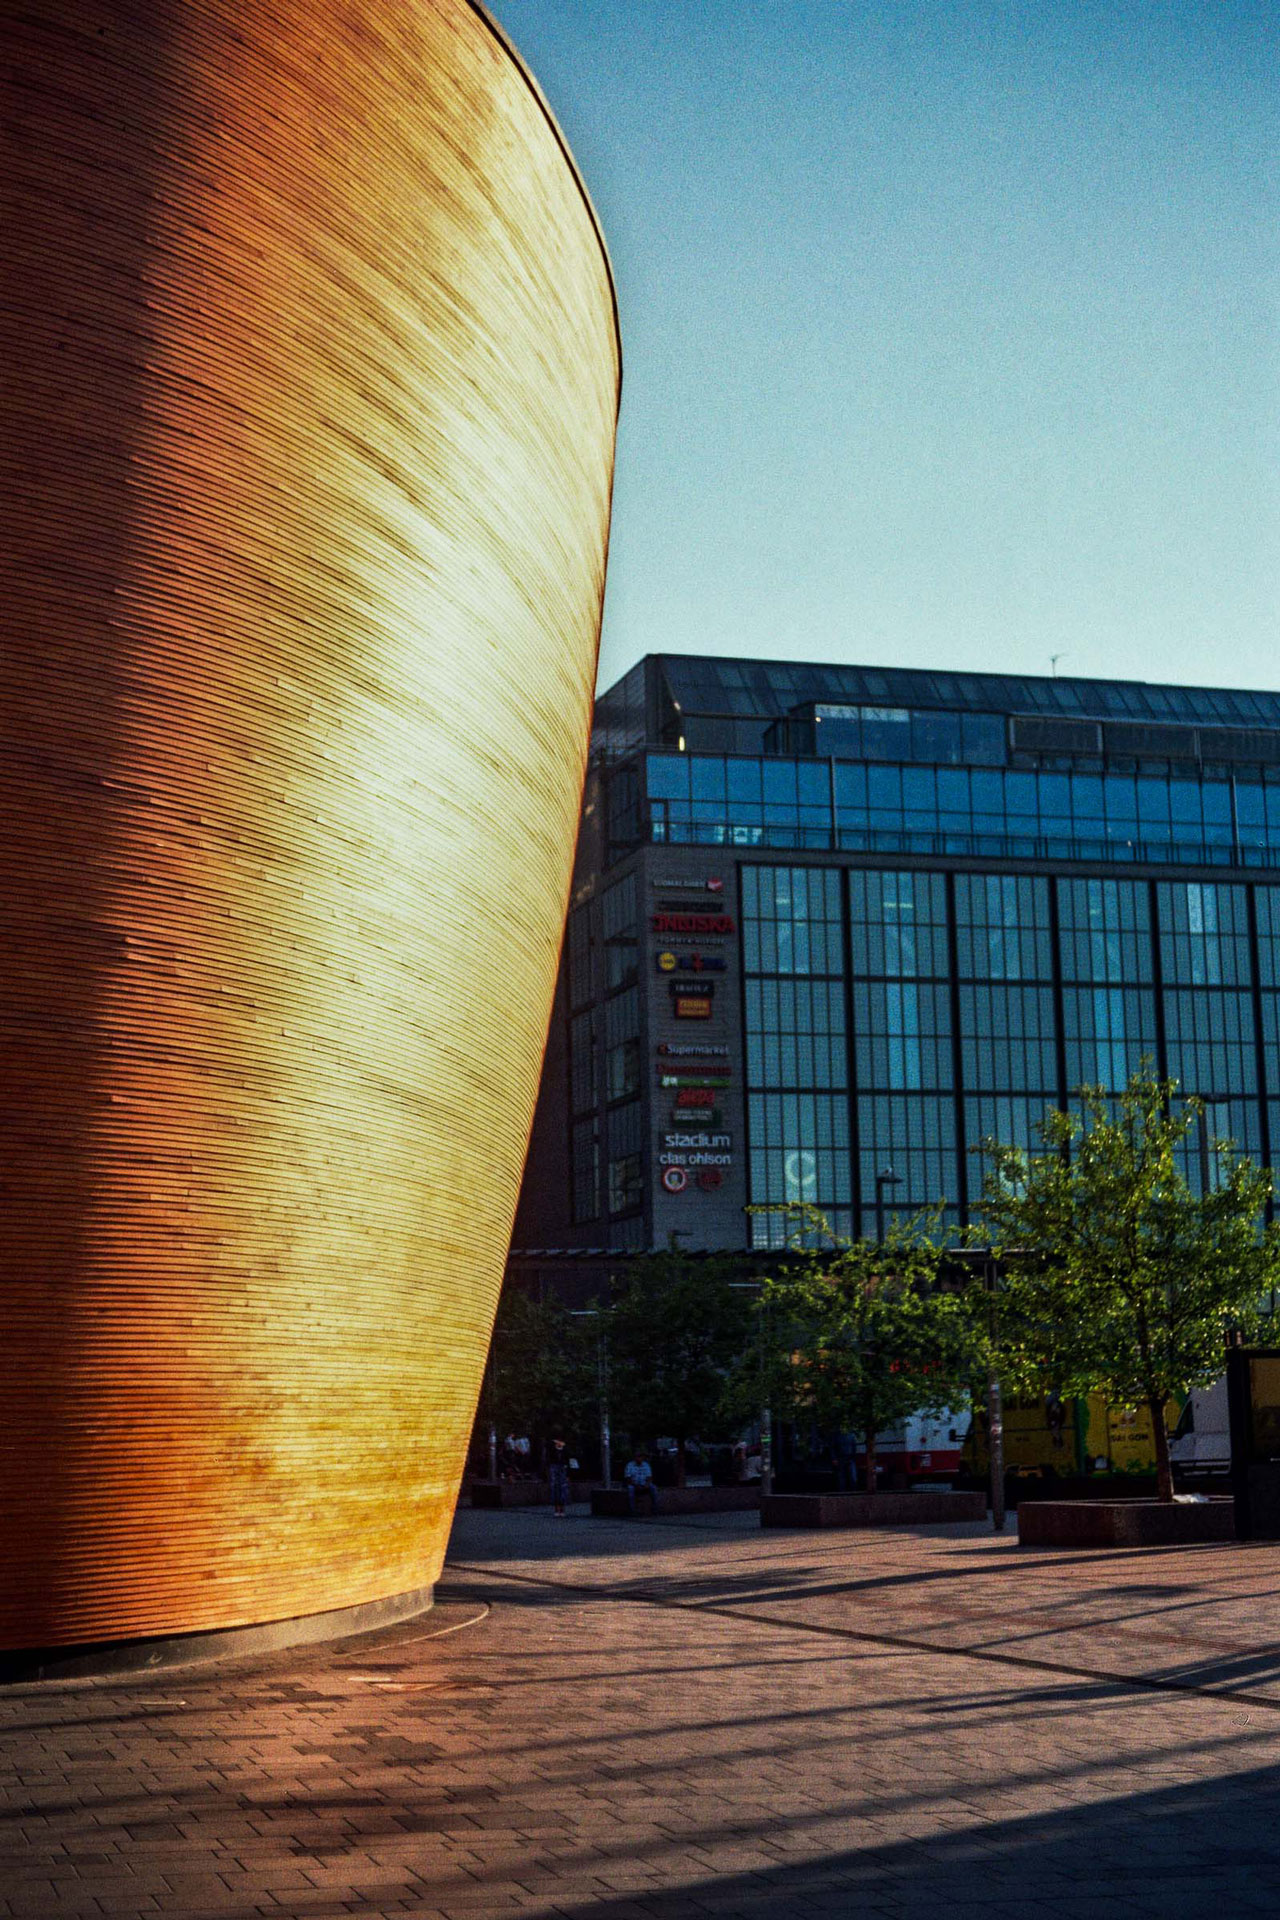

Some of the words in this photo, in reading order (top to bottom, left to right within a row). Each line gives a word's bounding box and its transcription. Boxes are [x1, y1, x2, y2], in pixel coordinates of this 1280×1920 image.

[664, 1132, 731, 1147] stadium
[659, 1152, 686, 1165] clas
[688, 1152, 732, 1165] ohlson
